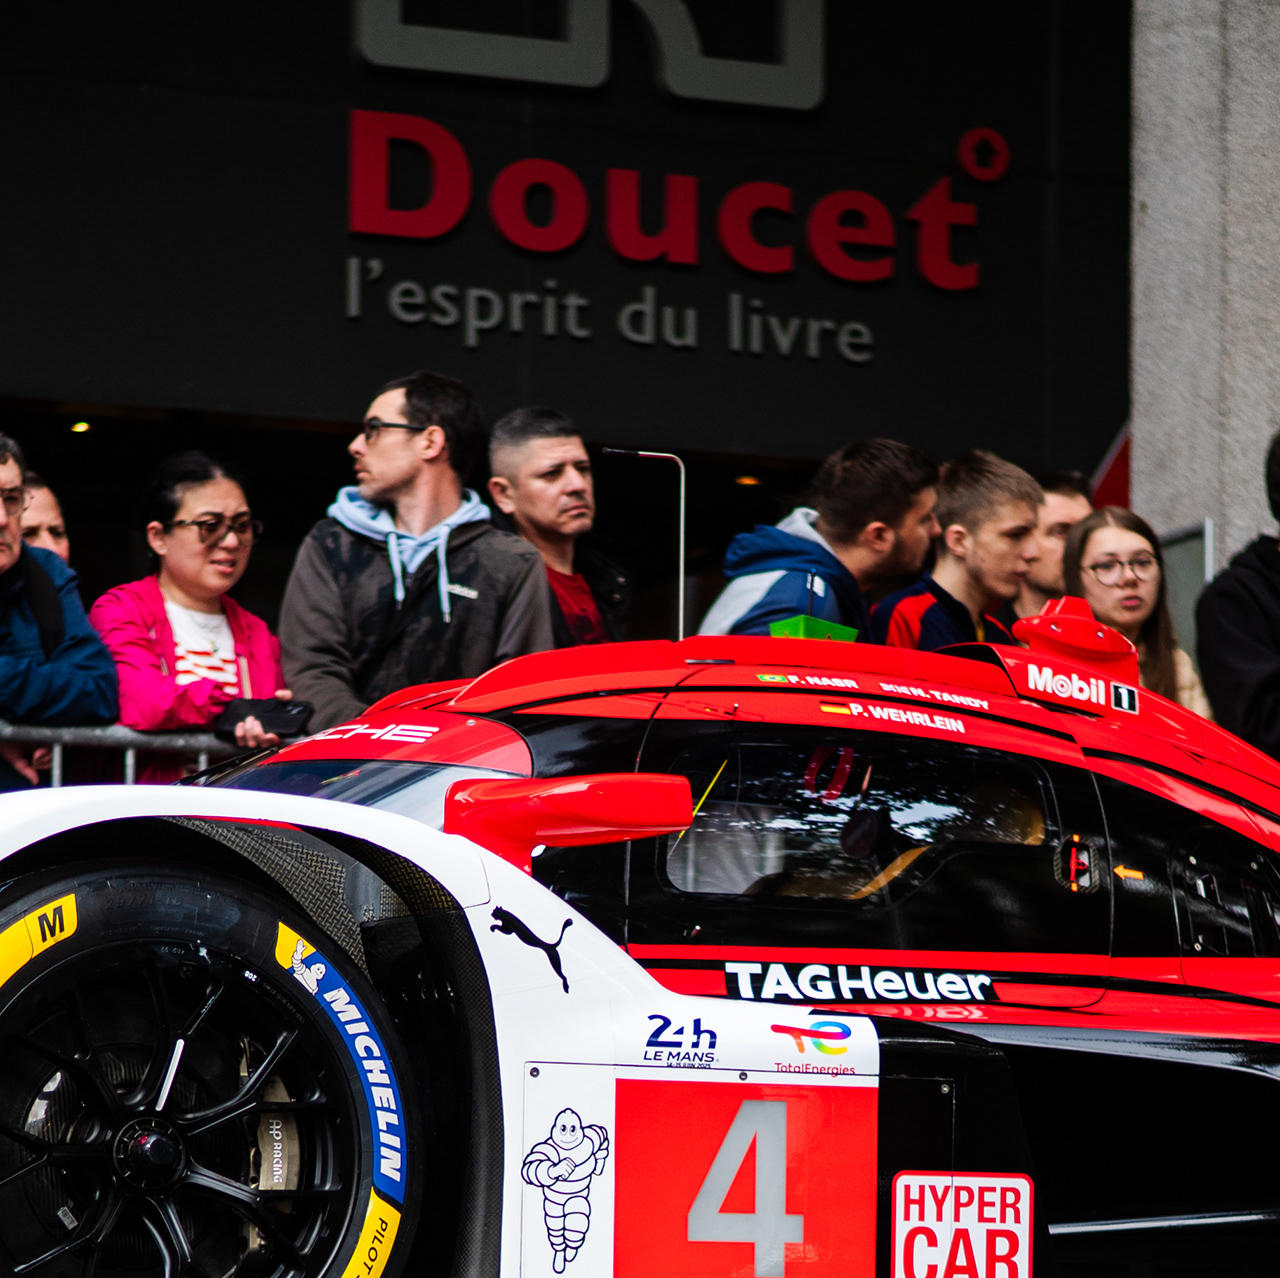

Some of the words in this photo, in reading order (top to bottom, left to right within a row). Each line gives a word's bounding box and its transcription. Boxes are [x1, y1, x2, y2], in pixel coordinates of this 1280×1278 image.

[347, 108, 982, 291] Doucet
[346, 256, 592, 349] l'esprit
[617, 285, 700, 349] du
[727, 292, 875, 363] livre
[786, 675, 805, 685] F.
[805, 675, 860, 689] NASR
[909, 686, 930, 699] N.
[928, 690, 990, 711] TANDY
[1027, 663, 1106, 706] Mobil
[849, 702, 869, 717] P.
[867, 704, 966, 734] WEHRLEIN
[37, 904, 66, 944] M
[645, 1013, 718, 1050] 24h
[643, 1050, 664, 1061] LE
[666, 1051, 716, 1063] MANS
[774, 1062, 857, 1078] TotalEnergies
[323, 987, 402, 1183] MICHELIN
[272, 1142, 283, 1183] RACING
[687, 1099, 804, 1278] 4
[902, 1184, 1022, 1225] HYPER
[363, 1217, 389, 1276] PILOT
